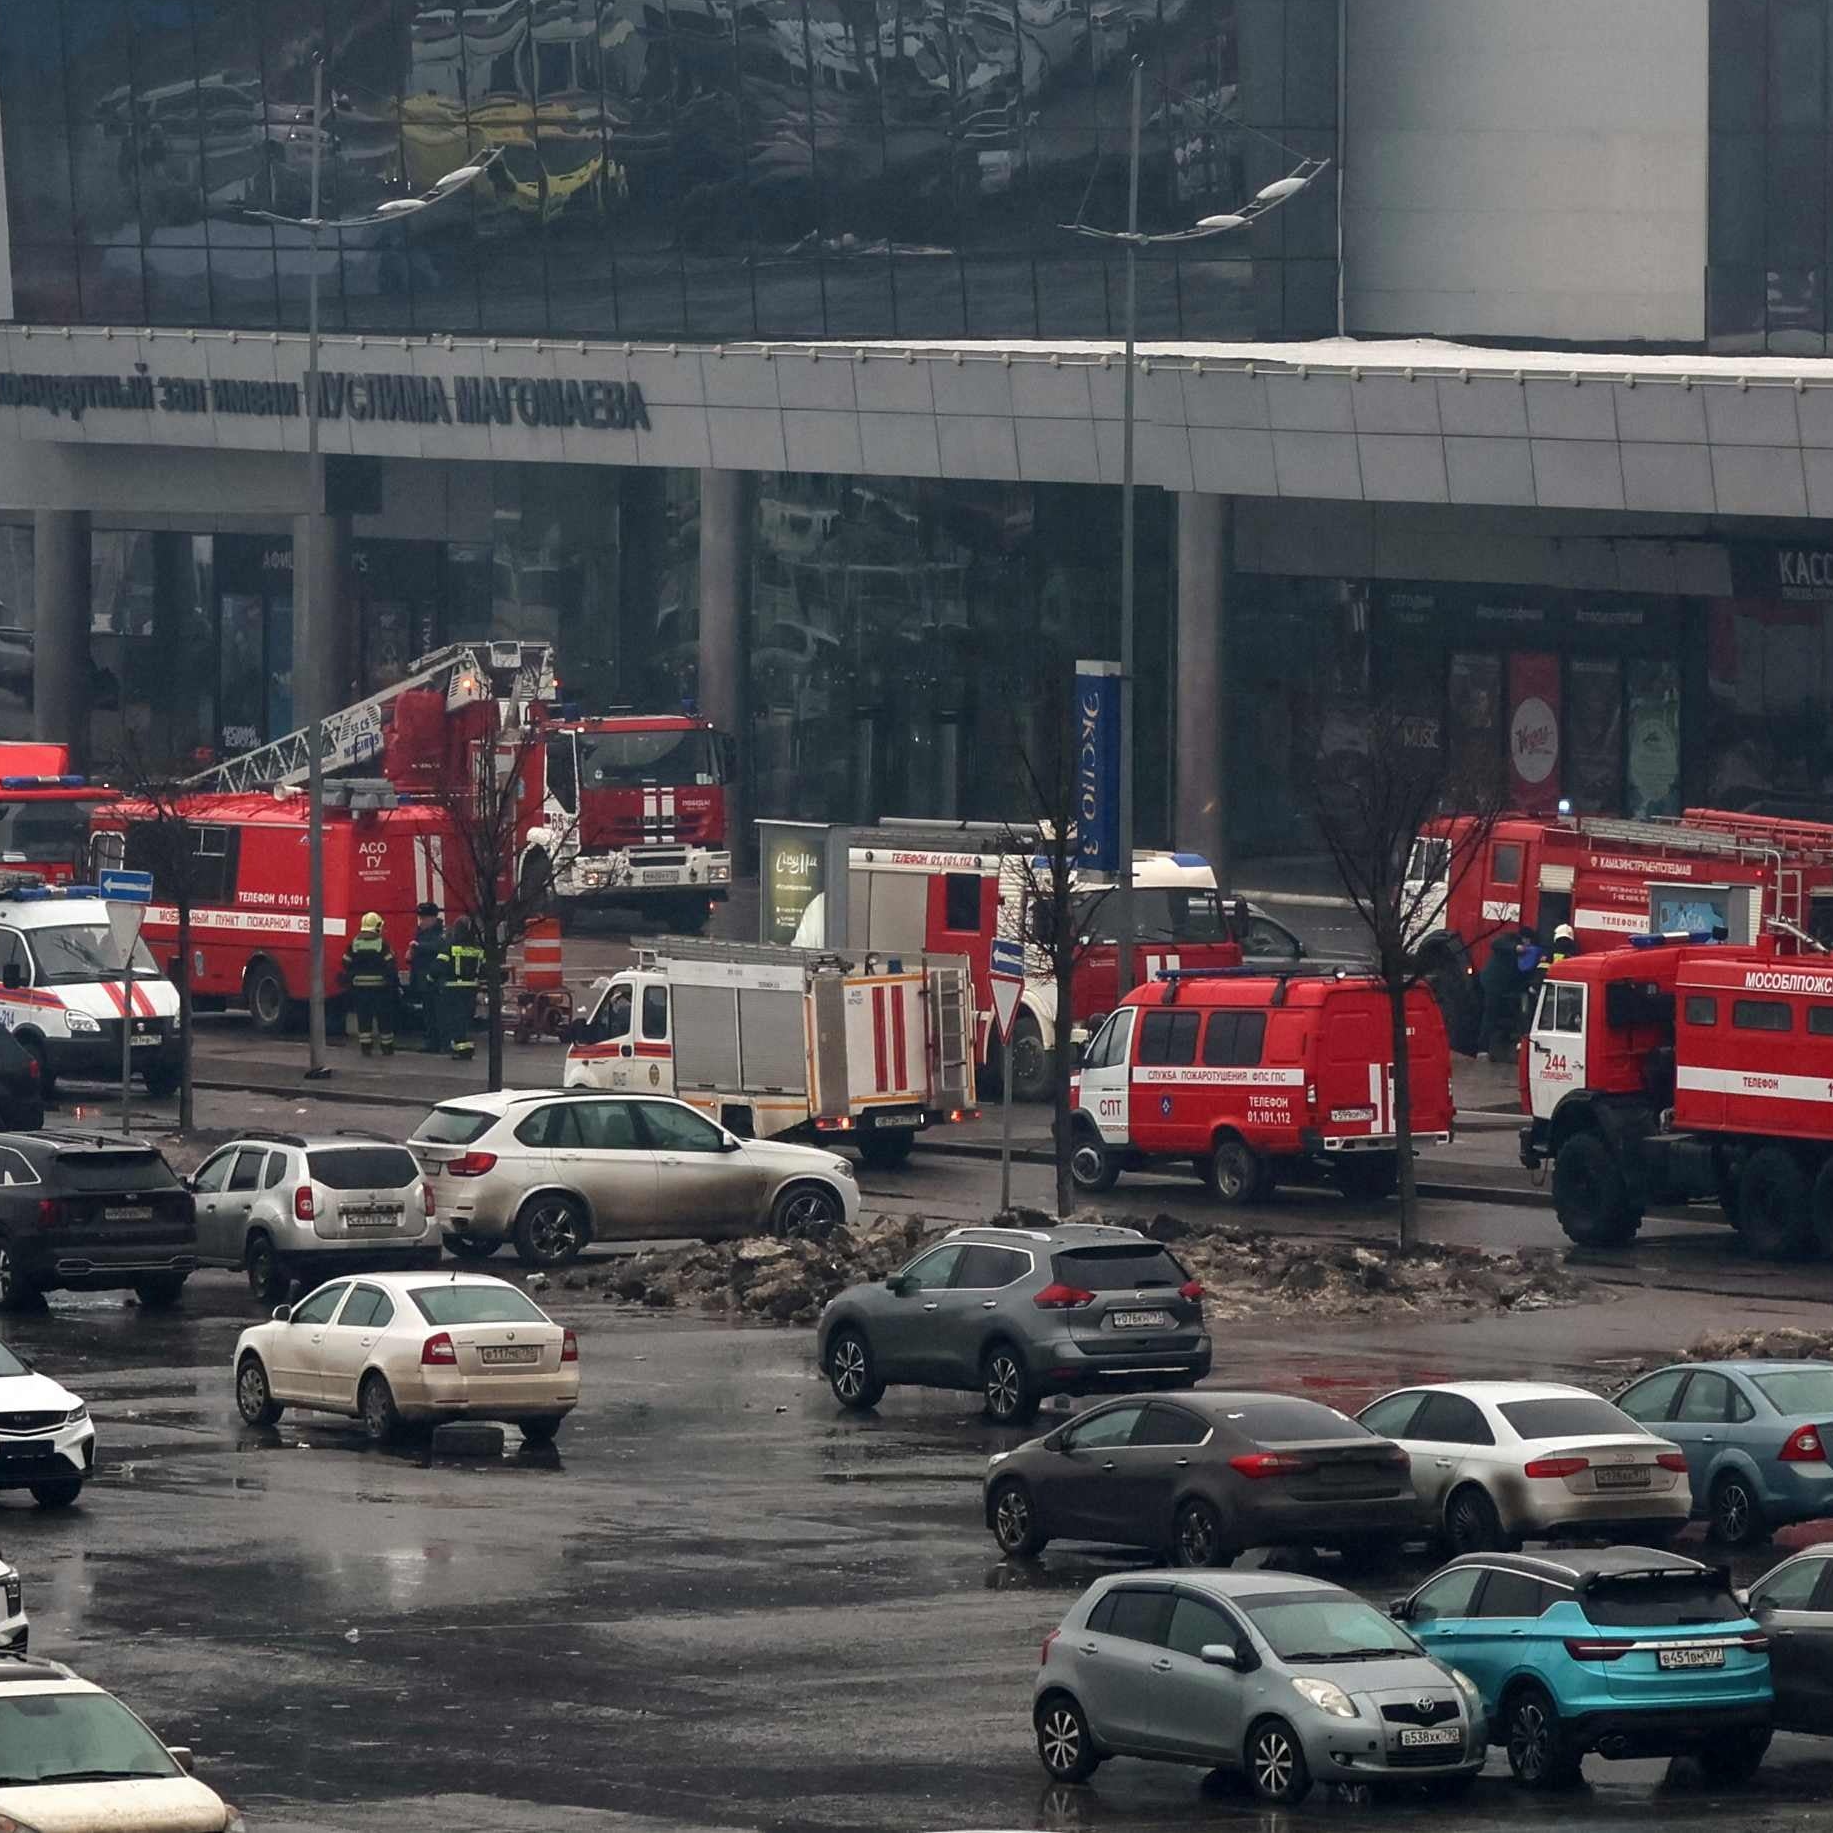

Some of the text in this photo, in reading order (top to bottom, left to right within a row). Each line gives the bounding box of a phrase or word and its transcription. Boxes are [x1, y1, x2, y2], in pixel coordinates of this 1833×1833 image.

[358, 842, 387, 854] АСО
[366, 856, 381, 868] ГУ
[892, 853, 927, 865] ТЕЛЕФОН
[238, 891, 275, 905] ТЕЛЕФОН
[216, 914, 240, 927] ПУНКТ
[246, 915, 292, 929] ПОЖАРНОЙ
[1602, 916, 1638, 927] ТЕЛЕФОН
[1544, 1054, 1567, 1071] 244
[1148, 1070, 1177, 1081] СЛУЖБА
[1181, 1071, 1248, 1082] ПОЖАРОТУШЕНИЯ
[1742, 1076, 1778, 1090] ТЕЛЕФОН
[1099, 1098, 1121, 1117] СПТ
[1248, 1096, 1288, 1107] ТЕЛЕФОН
[1247, 1112, 1291, 1124] 01,101,112
